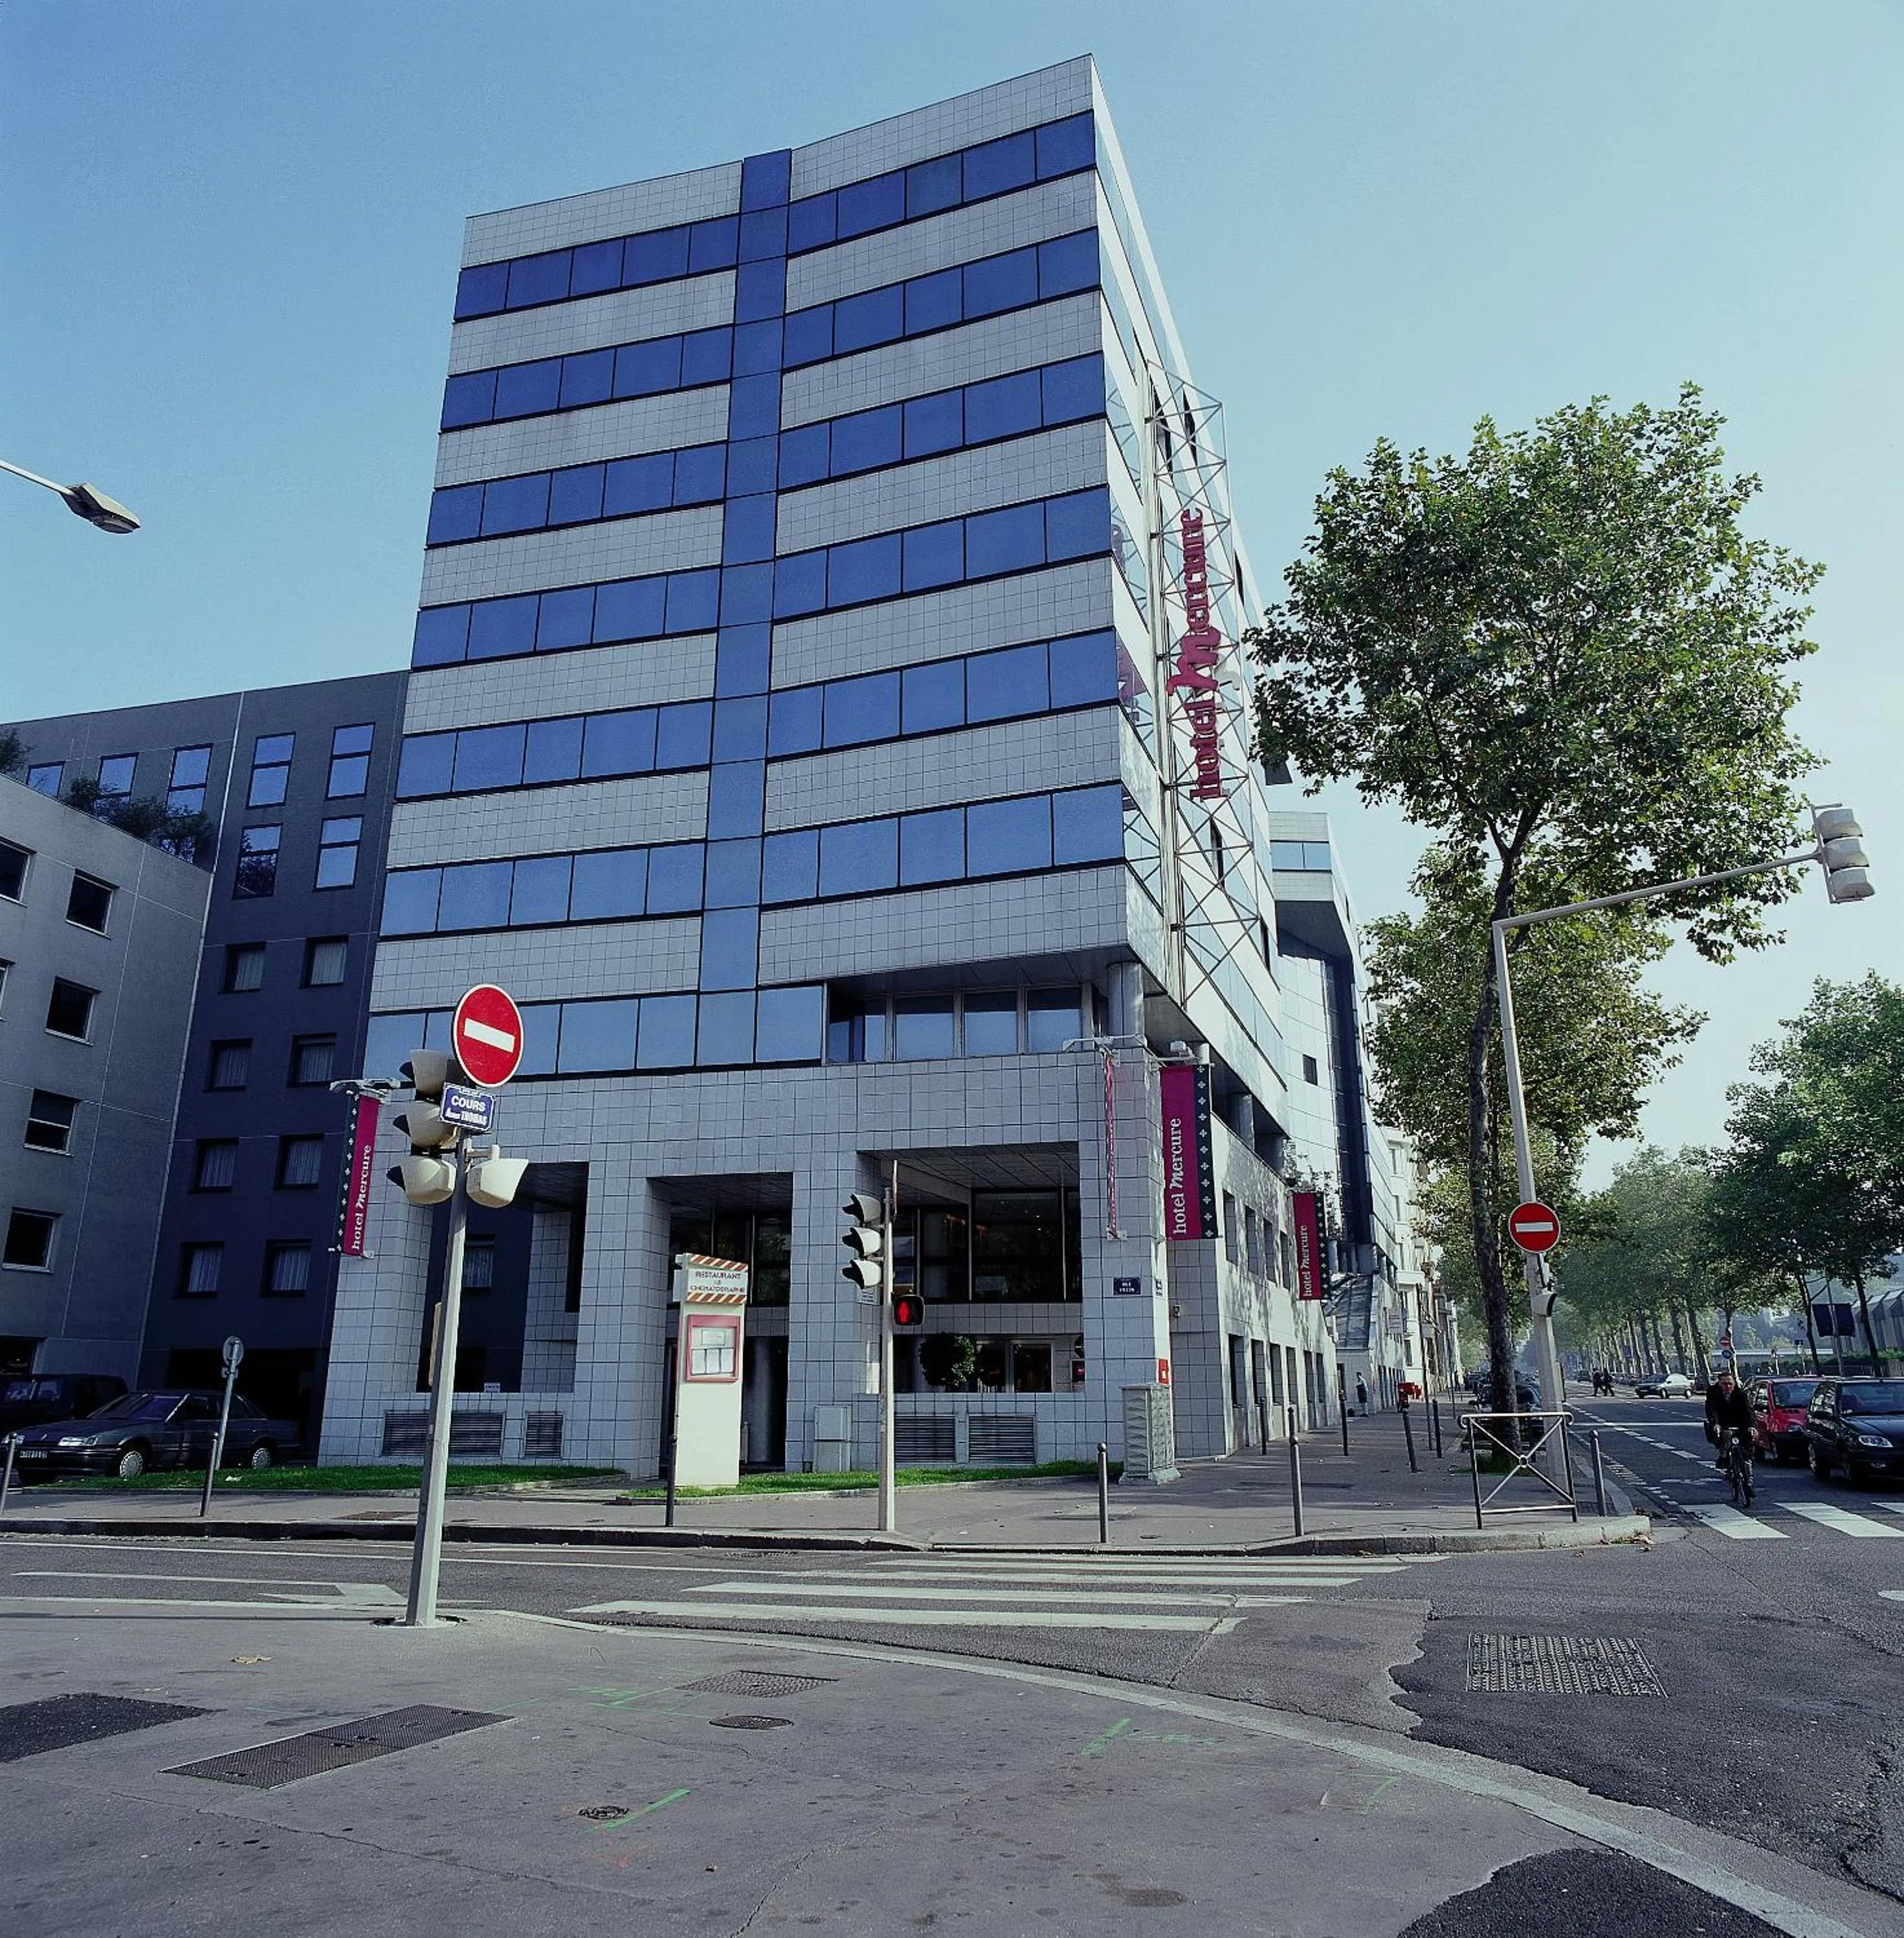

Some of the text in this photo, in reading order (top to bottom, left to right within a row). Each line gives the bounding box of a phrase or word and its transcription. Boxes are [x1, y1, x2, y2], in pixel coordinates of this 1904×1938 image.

[1184, 698, 1222, 801] hotel
[451, 1095, 486, 1112] COURS
[1171, 1192, 1186, 1234] hotel
[351, 1213, 364, 1250] hotel
[695, 1271, 742, 1280] RESTAURANT
[1301, 1270, 1312, 1297] hotel
